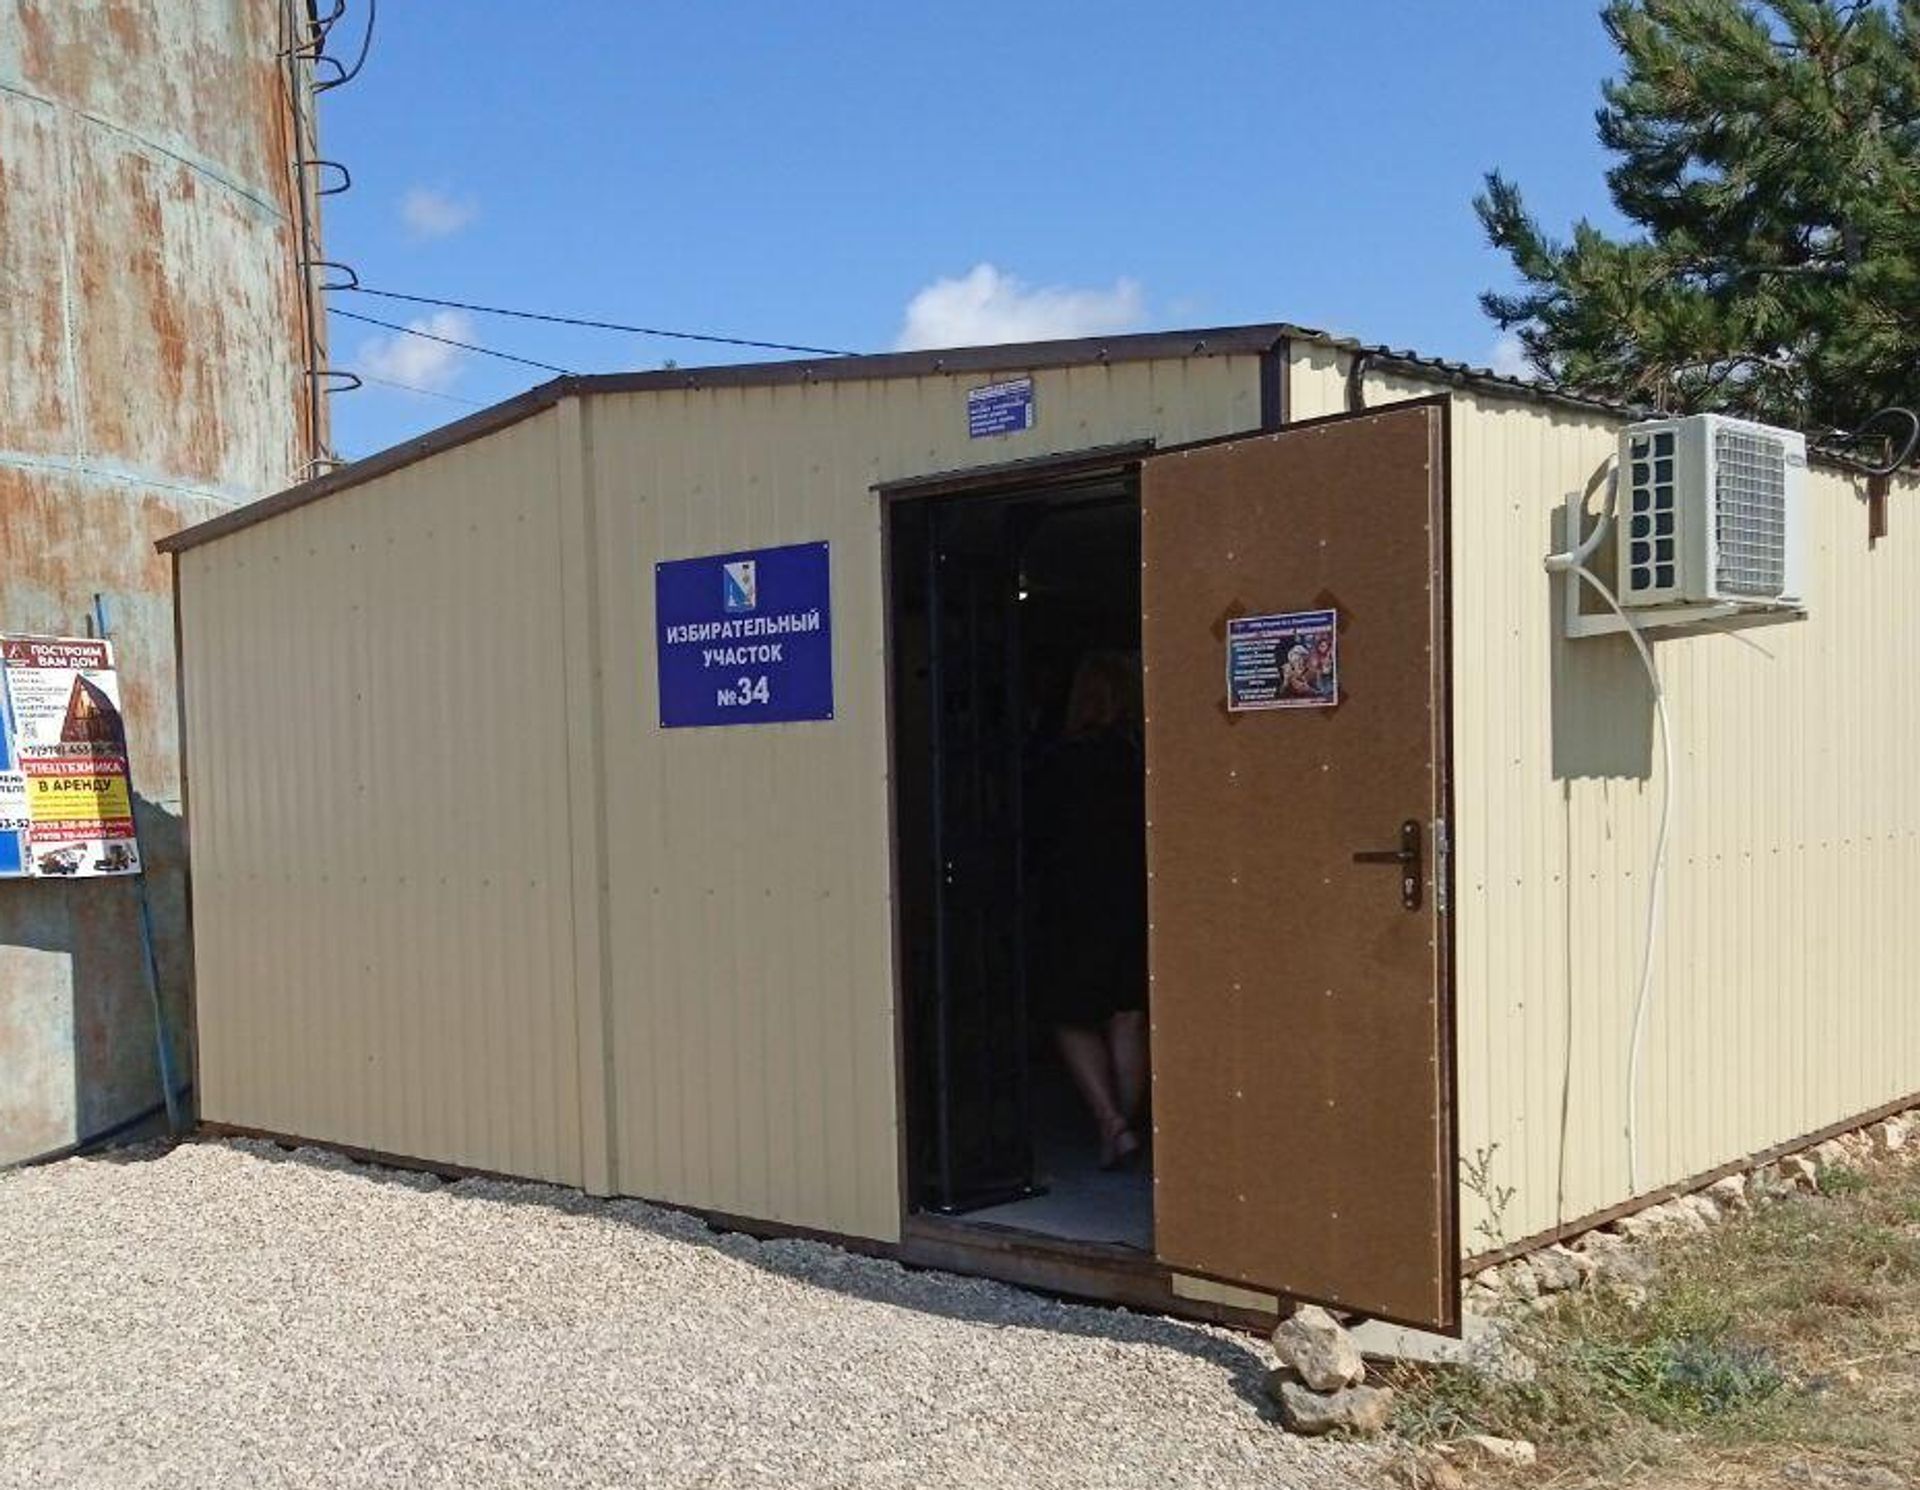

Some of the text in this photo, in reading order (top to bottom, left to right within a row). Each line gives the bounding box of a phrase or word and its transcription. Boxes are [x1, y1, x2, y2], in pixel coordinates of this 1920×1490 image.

[666, 608, 821, 645] ИЗБИРАТЕЛЬНЫЙ
[31, 644, 102, 658] ПОСТРОИМ
[702, 644, 783, 668] УЧАСТОК
[37, 656, 67, 667] ВАМ
[70, 656, 98, 669] ДОМ
[25, 761, 122, 775] СПЕЦТЕХНИКА
[38, 778, 111, 793] В АРЕНДУ
